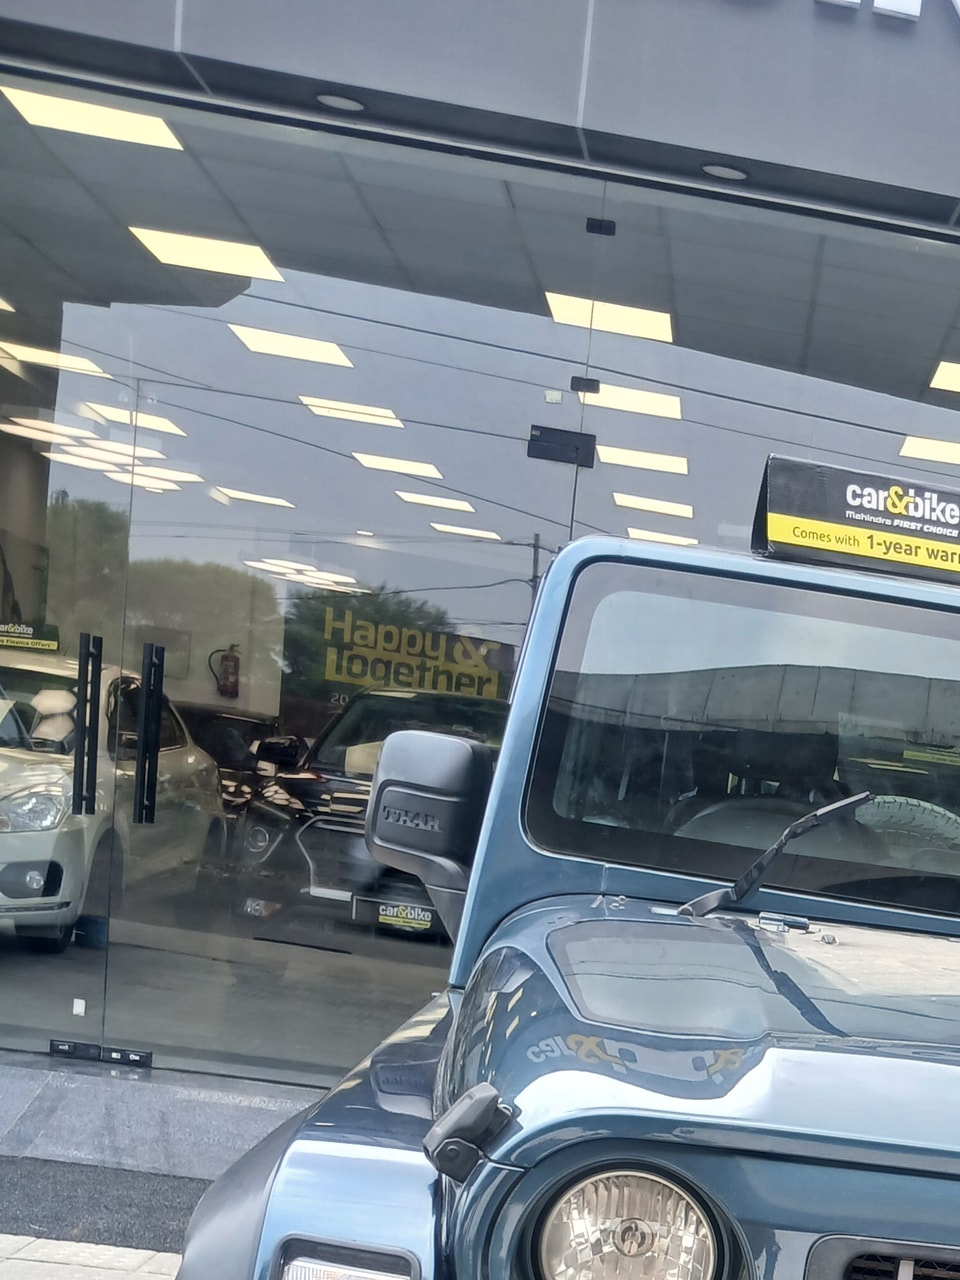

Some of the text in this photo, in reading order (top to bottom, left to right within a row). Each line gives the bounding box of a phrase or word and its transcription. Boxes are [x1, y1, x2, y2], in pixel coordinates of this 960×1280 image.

[846, 484, 960, 525] car&bike
[792, 526, 832, 544] Comes
[834, 534, 860, 548] with
[866, 534, 921, 557] 1-year
[845, 510, 960, 538] Mahindra FIRST CHOICE
[324, 607, 447, 663] Happy
[334, 648, 493, 696] Together
[379, 904, 432, 921] car&bike
